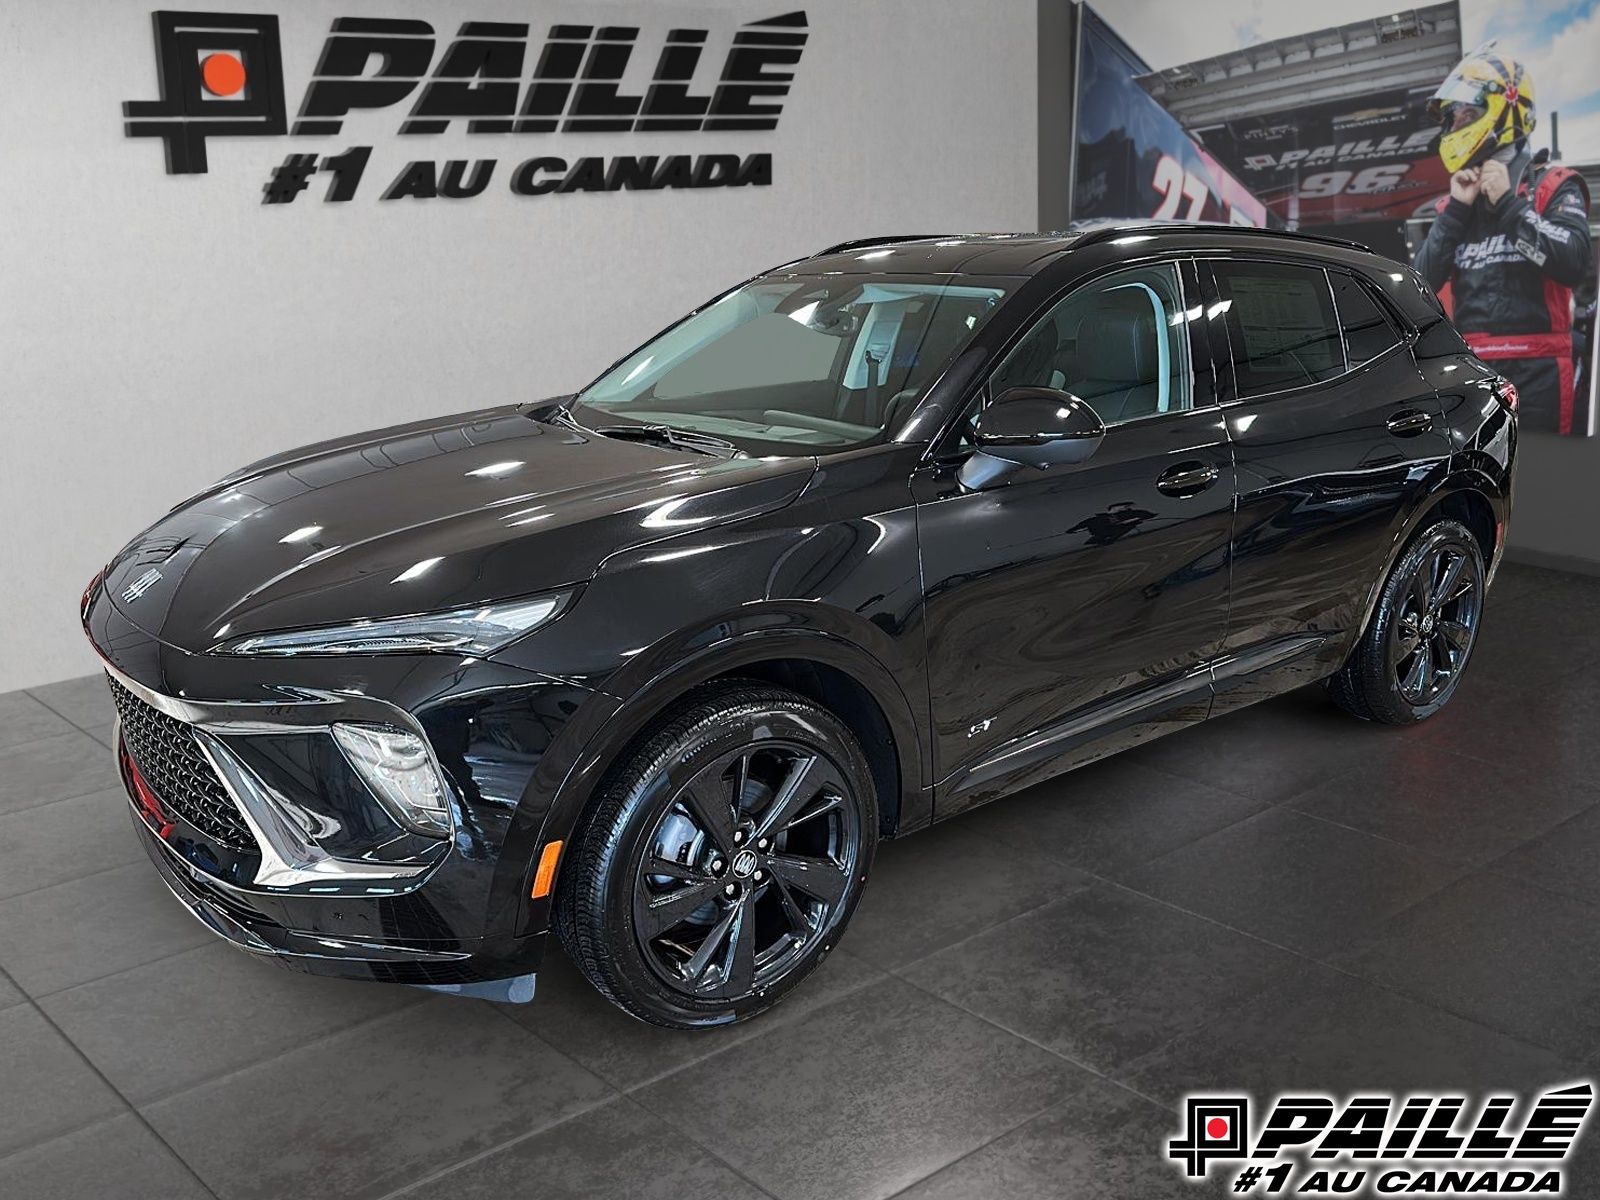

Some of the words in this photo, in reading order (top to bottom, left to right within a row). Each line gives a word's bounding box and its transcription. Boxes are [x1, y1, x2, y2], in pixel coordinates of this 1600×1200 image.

[290, 10, 809, 136] PAILLÉ
[1333, 113, 1408, 130] CHEVROLET
[260, 146, 373, 206] #1
[379, 159, 497, 202] AU
[509, 153, 773, 196] CANADA
[1299, 163, 1411, 199] 96
[1304, 158, 1332, 168] AU
[1337, 146, 1429, 164] CANADA
[1152, 154, 1210, 221] 27
